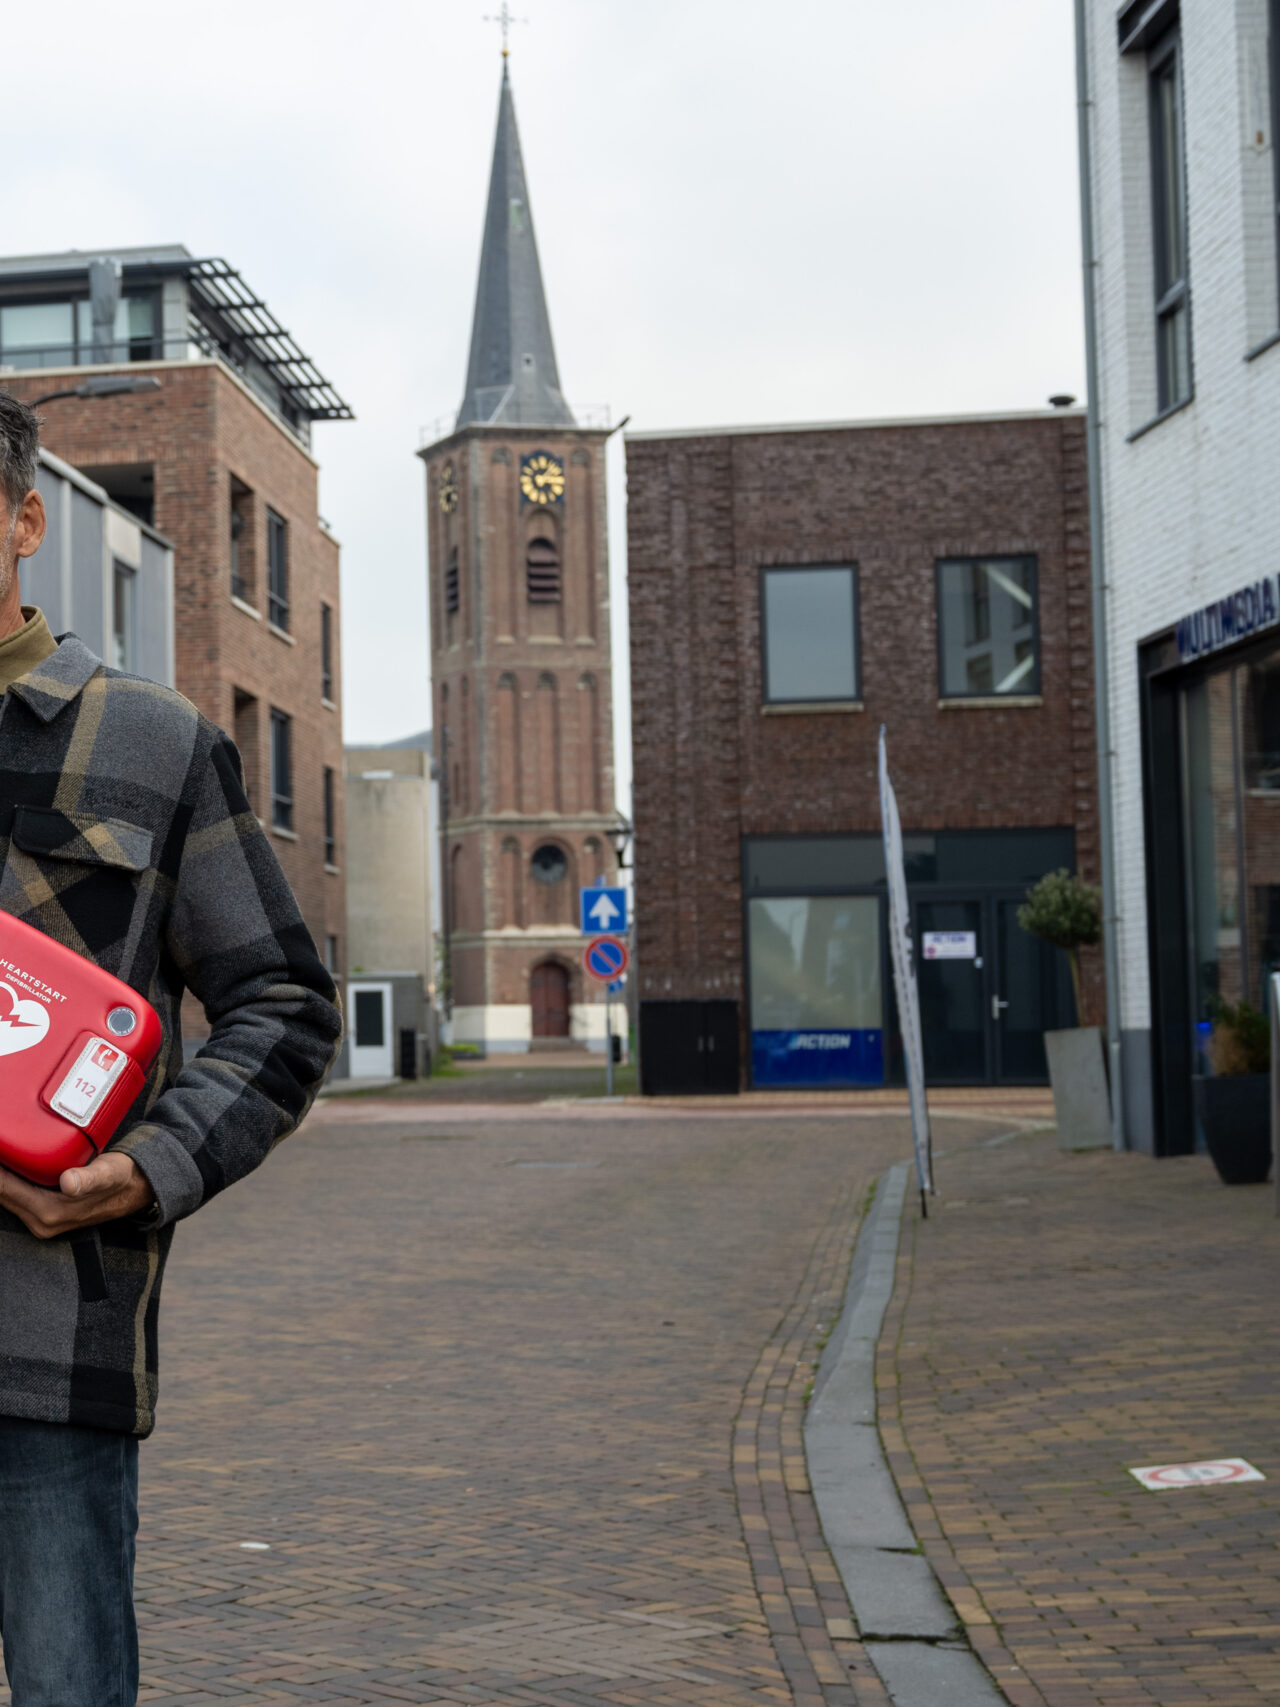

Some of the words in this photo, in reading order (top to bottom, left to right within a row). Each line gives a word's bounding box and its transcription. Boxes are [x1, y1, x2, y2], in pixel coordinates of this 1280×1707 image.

[0, 958, 67, 1003] HEARTSTART
[5, 973, 51, 1003] DEFIBRILLATOR
[75, 1077, 97, 1098] 112
